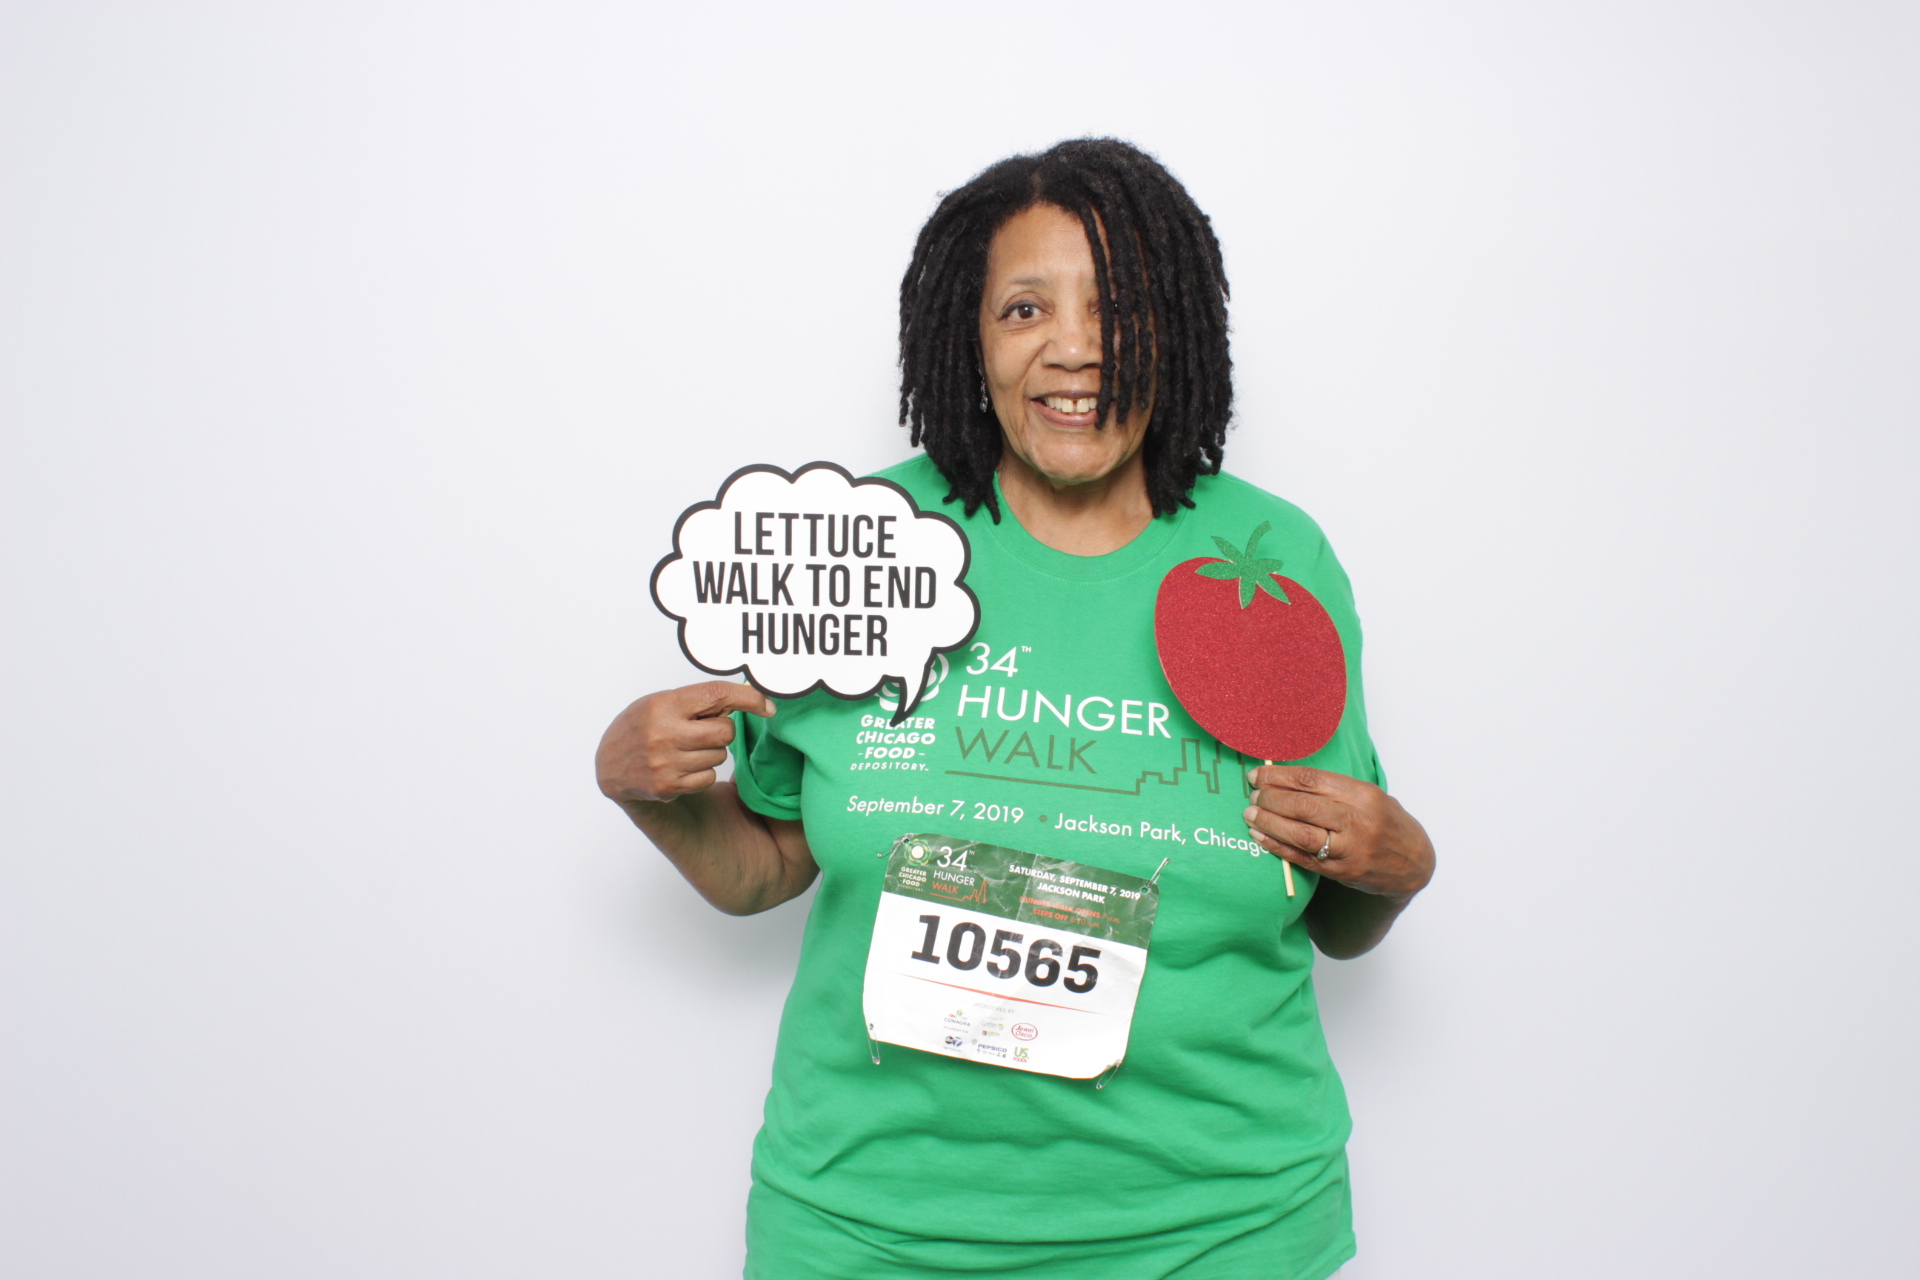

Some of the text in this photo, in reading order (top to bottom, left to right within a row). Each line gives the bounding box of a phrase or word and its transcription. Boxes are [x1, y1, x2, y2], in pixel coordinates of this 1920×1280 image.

[734, 511, 897, 559] LETTUCE
[692, 560, 937, 609] WALK TO END
[741, 611, 888, 657] HUNGER
[957, 684, 1172, 739] HUNGER
[856, 730, 936, 745] CHICAGO
[955, 726, 1098, 775] WALK
[846, 795, 1025, 824] September 7, 2019
[1054, 812, 1132, 837] Jackson
[1139, 821, 1187, 846] Park,
[898, 871, 927, 883] CHICAGO
[900, 866, 927, 877] GREATER
[933, 869, 976, 887] HUNGER
[932, 881, 960, 895] WALK
[1008, 864, 1141, 901] SATURDAY, SEPTEMBER 7, 2019
[1036, 882, 1106, 904] JACKSON PARK
[1032, 907, 1054, 919] STEPS
[1054, 912, 1069, 921] OFF
[1052, 901, 1075, 914] WALK
[1075, 907, 1101, 919] OPENS
[910, 914, 1102, 994] 10565
[943, 1017, 971, 1027] CONAGRA
[1015, 1024, 1035, 1034] Jewel
[977, 1043, 1008, 1053] PEPSICO
[1013, 1046, 1030, 1058] US
